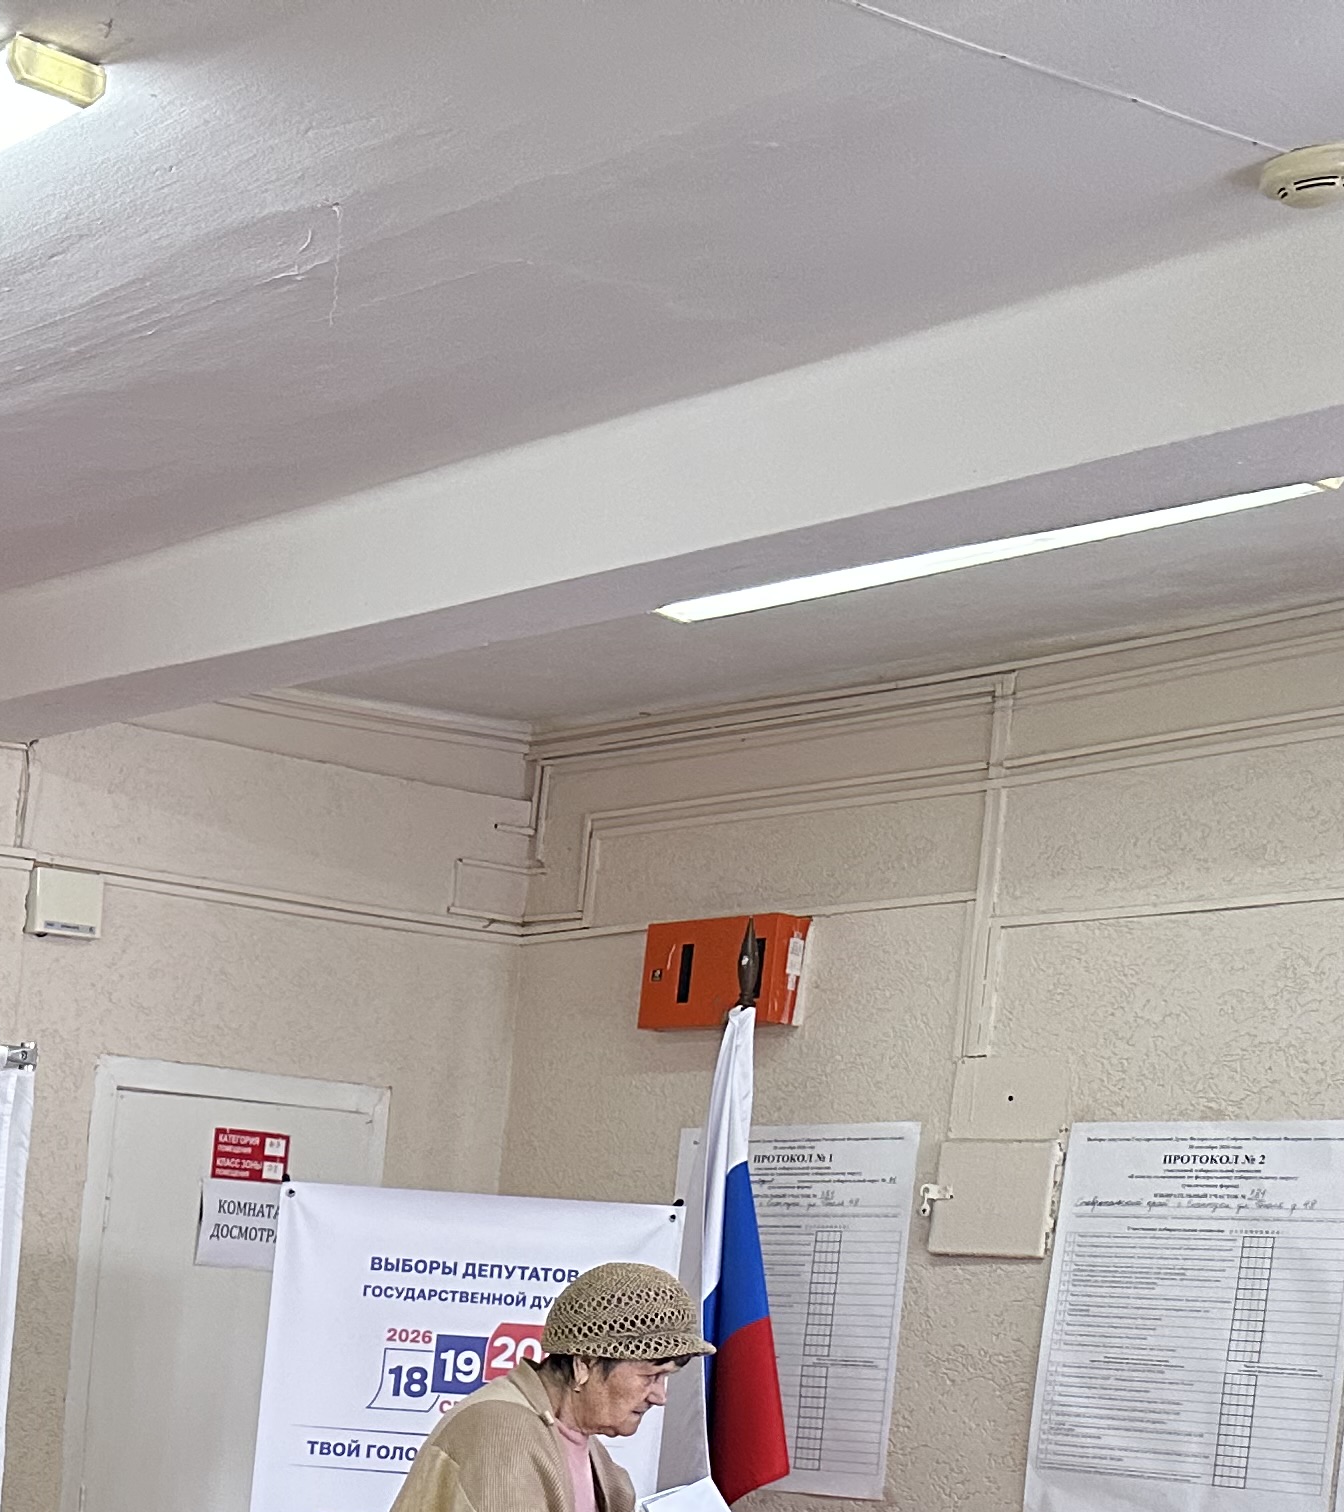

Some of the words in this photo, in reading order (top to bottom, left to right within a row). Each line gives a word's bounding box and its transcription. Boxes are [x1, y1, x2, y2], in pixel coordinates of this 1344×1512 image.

[753, 1153, 814, 1164] ПРОТОКОЛ
[1162, 1154, 1240, 1165] ПРОТОКОЛ
[1241, 1154, 1256, 1165] №
[1258, 1154, 1266, 1165] 2
[370, 1256, 458, 1276] ВЫБОРЫ
[462, 1262, 580, 1283] ДЕПУТАТОВ
[363, 1284, 527, 1307] ГОСУДАРСТВЕННОЙ
[530, 1295, 558, 1310] ДУ
[386, 1327, 433, 1344] 2026
[491, 1336, 542, 1369] 20
[440, 1349, 481, 1383] 19
[388, 1365, 428, 1398] 18
[307, 1440, 360, 1458] ТВОЙ
